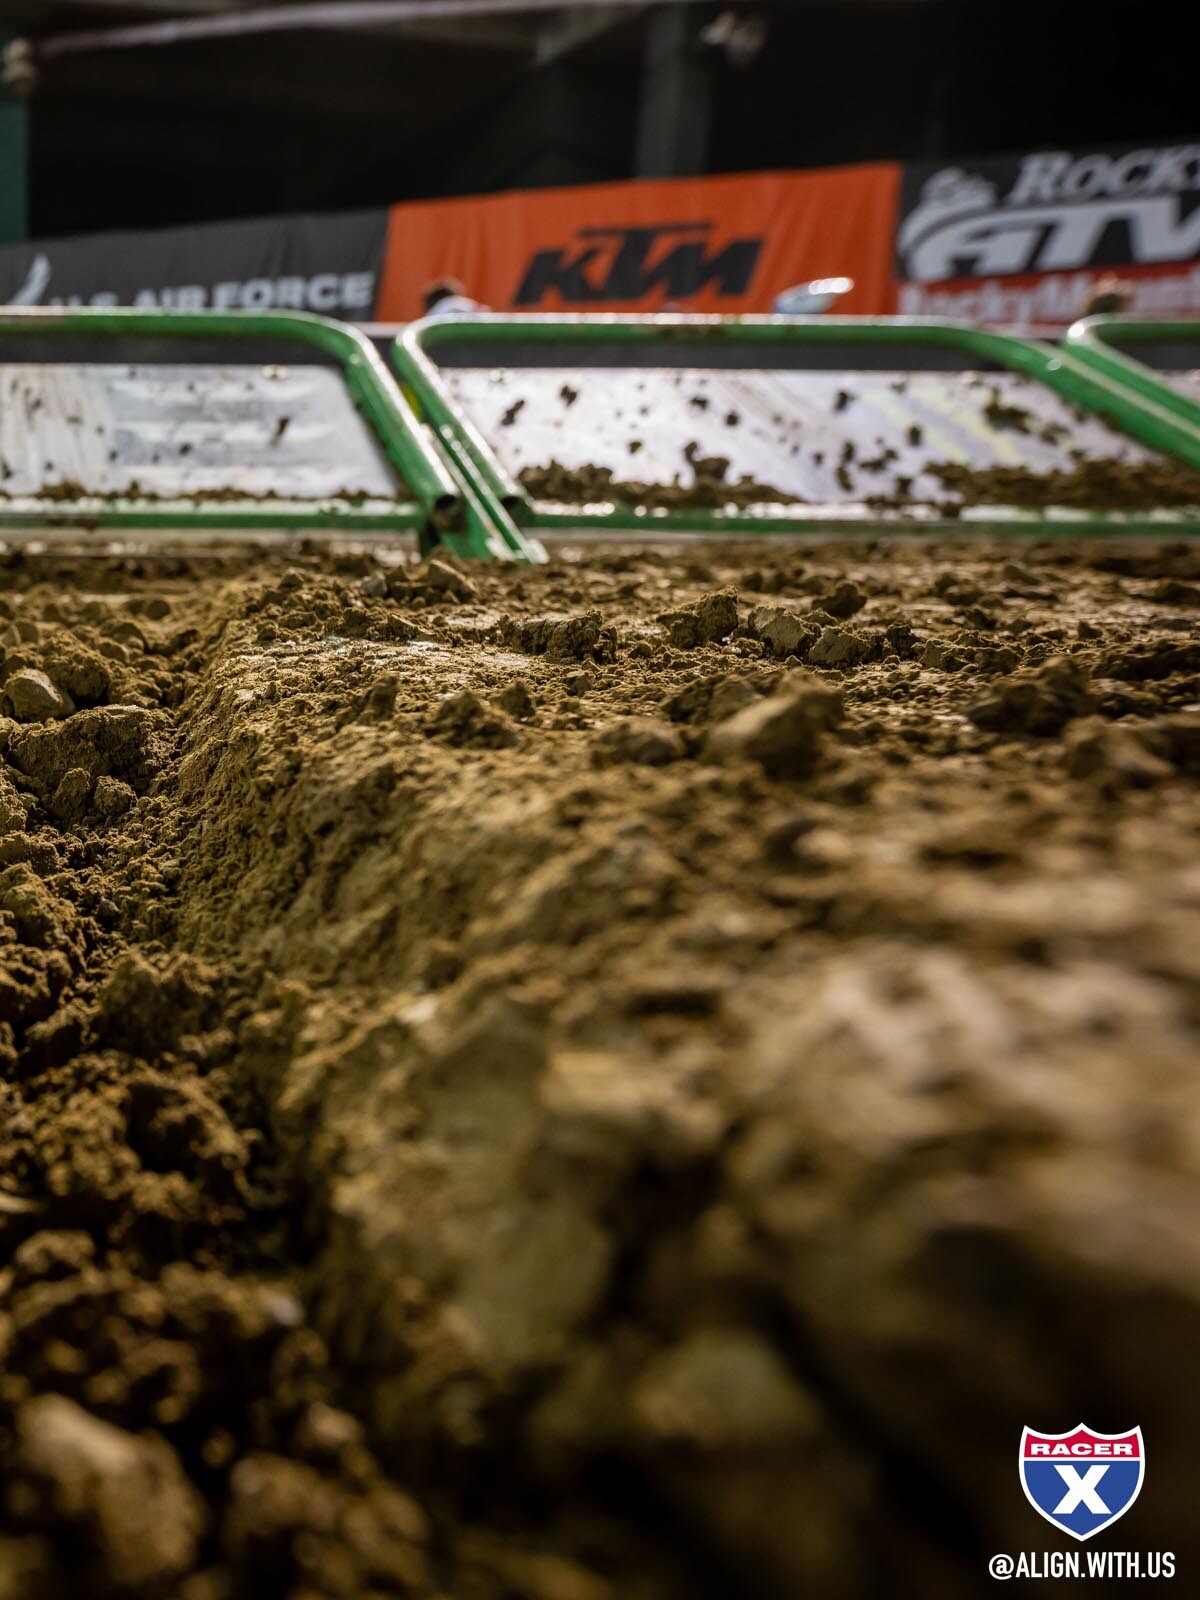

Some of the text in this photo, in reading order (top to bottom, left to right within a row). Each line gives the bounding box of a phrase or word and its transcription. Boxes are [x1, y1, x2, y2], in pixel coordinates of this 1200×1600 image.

[511, 221, 765, 306] KTM
[907, 197, 1200, 282] ATV
[213, 271, 375, 312] FORCE
